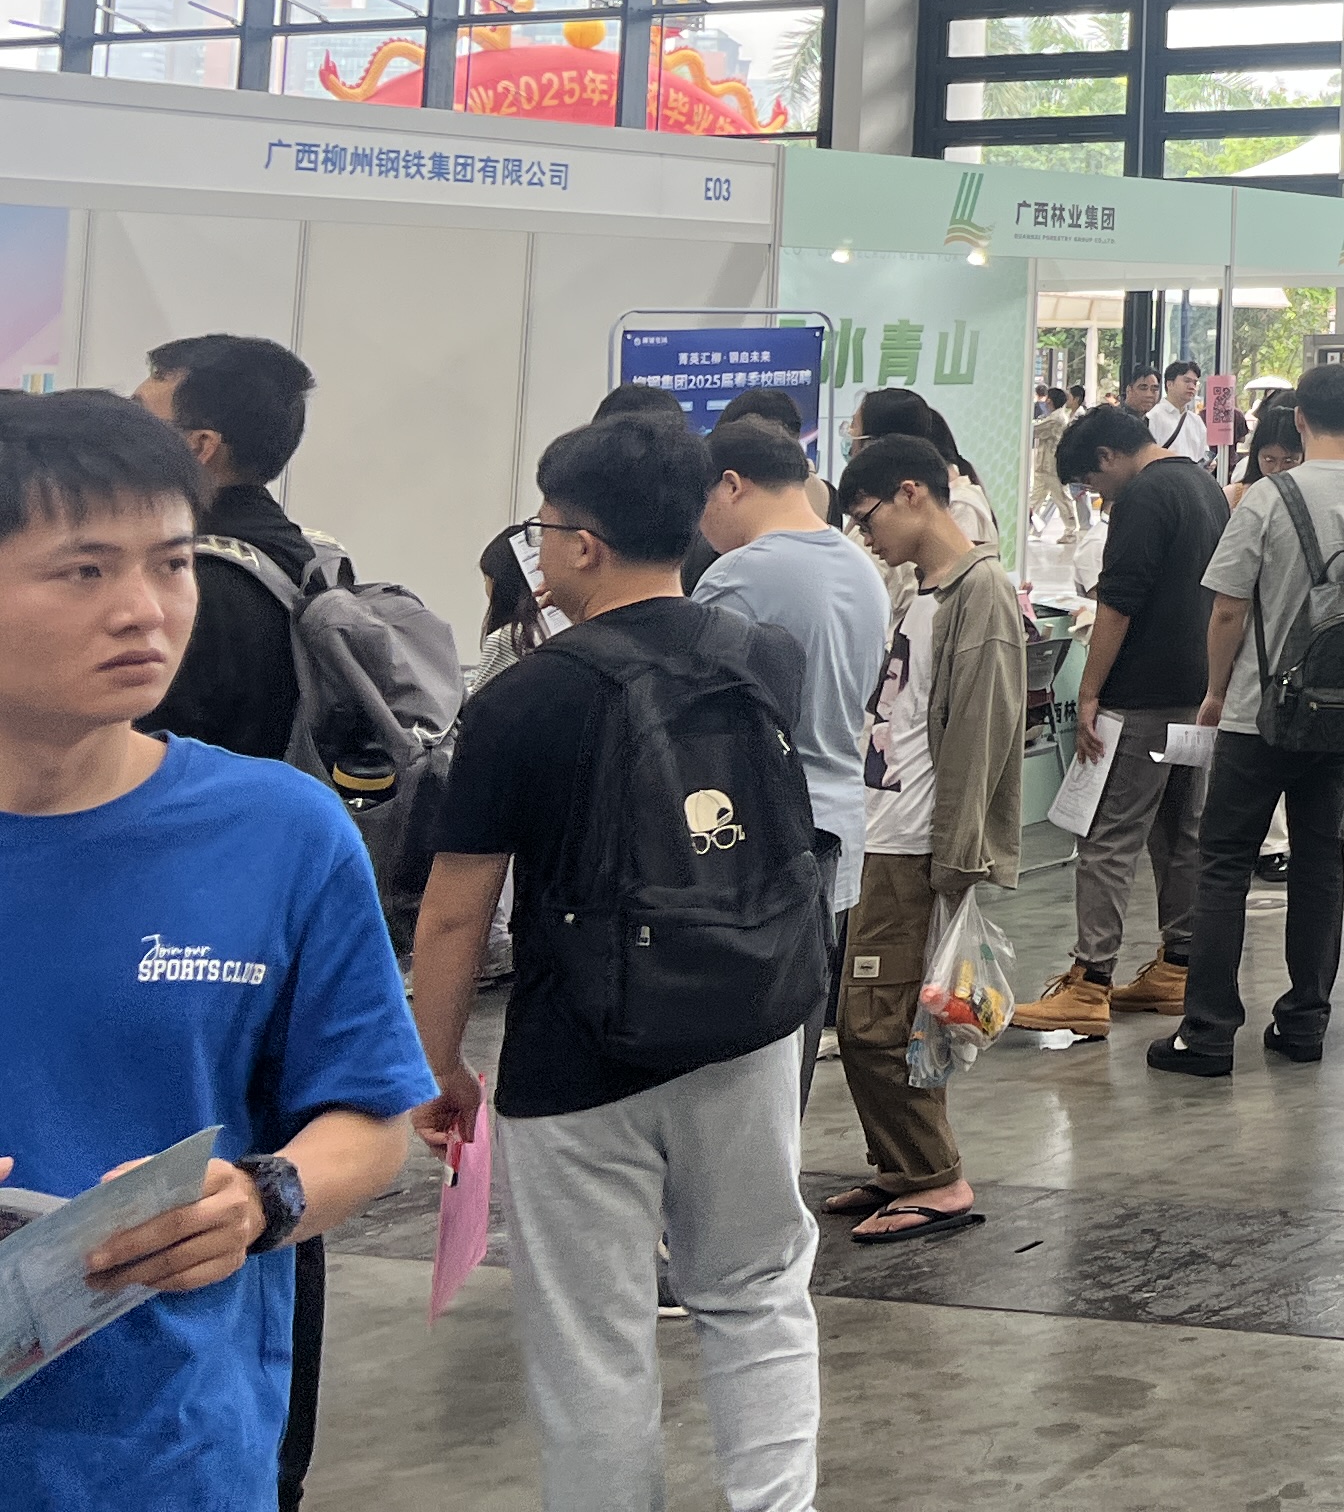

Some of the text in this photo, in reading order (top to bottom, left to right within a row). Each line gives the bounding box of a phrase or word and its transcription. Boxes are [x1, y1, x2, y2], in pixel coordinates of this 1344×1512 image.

[265, 139, 569, 191] 广西柳州钢铁集团有限公司
[704, 177, 731, 201] E03
[1015, 200, 1116, 230] 广西林业集团
[779, 318, 980, 389] 水青山
[138, 958, 266, 985] SPORTS CLUB
